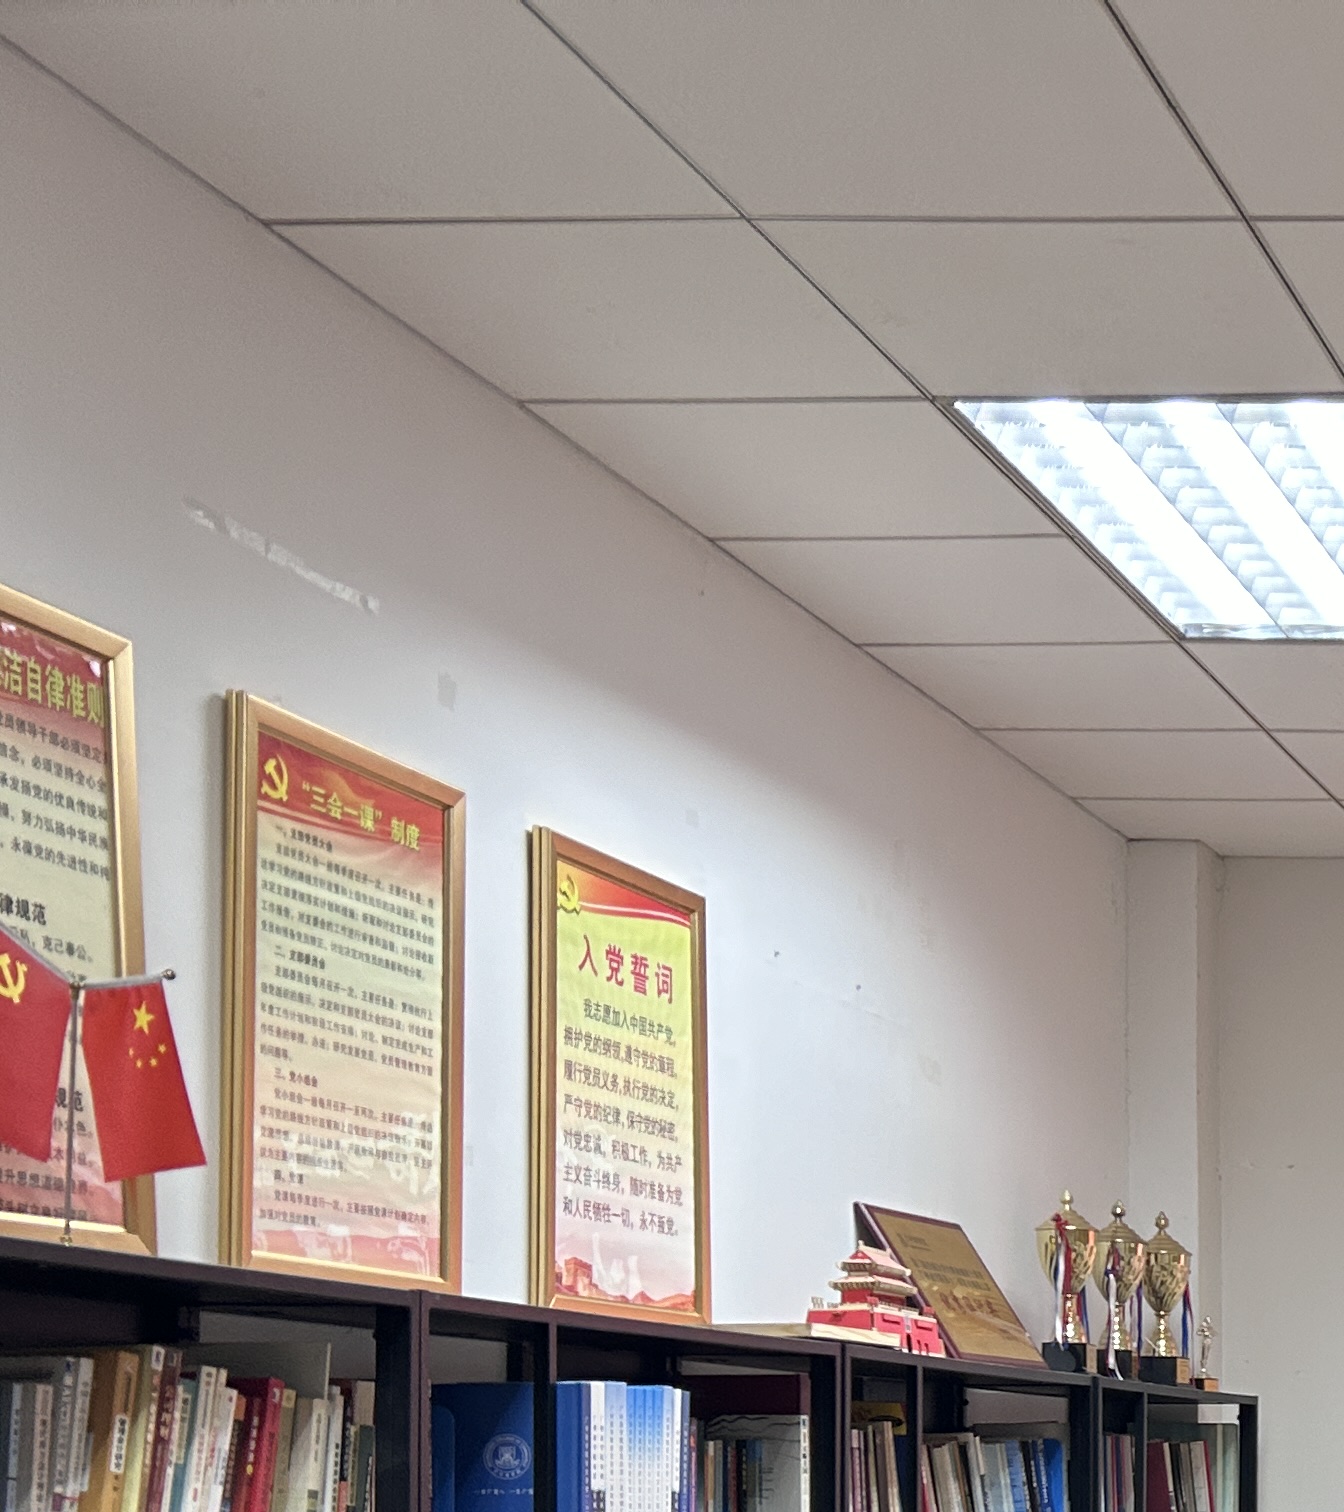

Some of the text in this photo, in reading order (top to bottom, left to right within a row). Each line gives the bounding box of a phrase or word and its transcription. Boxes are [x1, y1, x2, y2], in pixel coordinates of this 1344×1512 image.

[0, 647, 104, 728] 洁自律准则
[578, 934, 673, 1004] 入党誓词
